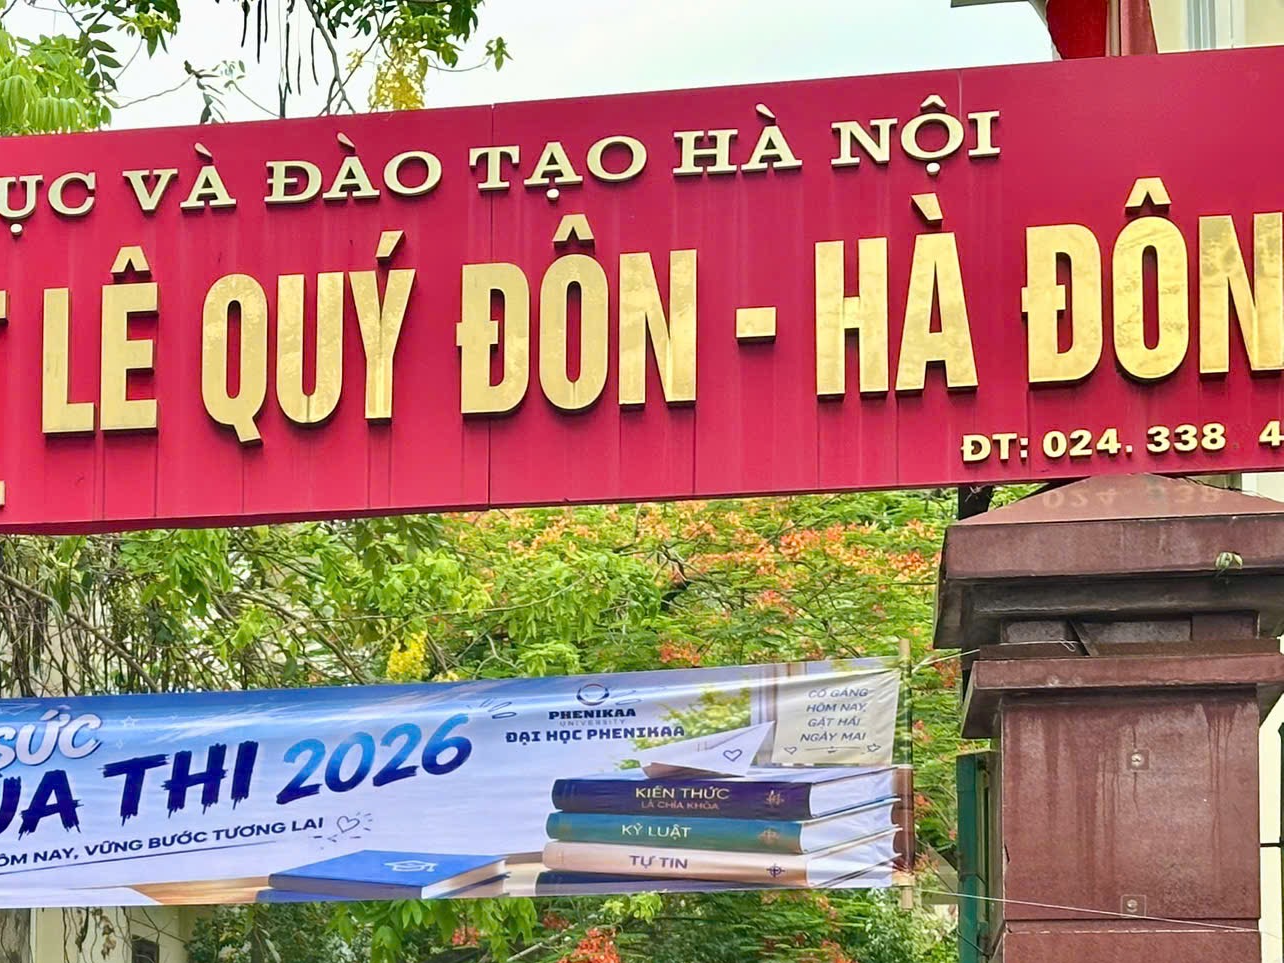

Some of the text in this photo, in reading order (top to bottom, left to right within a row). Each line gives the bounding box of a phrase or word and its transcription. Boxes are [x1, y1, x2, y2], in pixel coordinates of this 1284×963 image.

[123, 142, 237, 213] VÀ
[265, 133, 443, 206] ĐÀO
[469, 135, 649, 203] TẠO
[672, 103, 803, 177] HÀ
[830, 94, 1002, 177] NỘI
[40, 245, 160, 436] LÊ
[199, 229, 415, 446] QUÝ
[455, 213, 697, 417] ĐÔN
[734, 305, 777, 345] -
[813, 193, 980, 399] HÀ
[960, 431, 1030, 463] ĐT:
[1041, 427, 1134, 459] 024.
[1146, 422, 1227, 453] 338
[548, 708, 637, 720] PHENIKAA
[806, 702, 836, 713] HÔM
[559, 719, 626, 728] UNIVERSITY
[505, 726, 686, 746] ĐẠI HỌC PHENIKAA
[840, 732, 866, 741] MAI
[101, 739, 259, 827] THI
[274, 712, 474, 806] 2026
[635, 784, 730, 800] KIẾN THỨC
[32, 847, 80, 863] NAY,
[84, 840, 143, 857] VỮNG
[148, 830, 207, 849] BƯỚC
[212, 822, 286, 842] TƯƠNG
[291, 816, 324, 832] LAI
[648, 823, 692, 840] LUẬT
[629, 855, 688, 869] TỰ TIN
